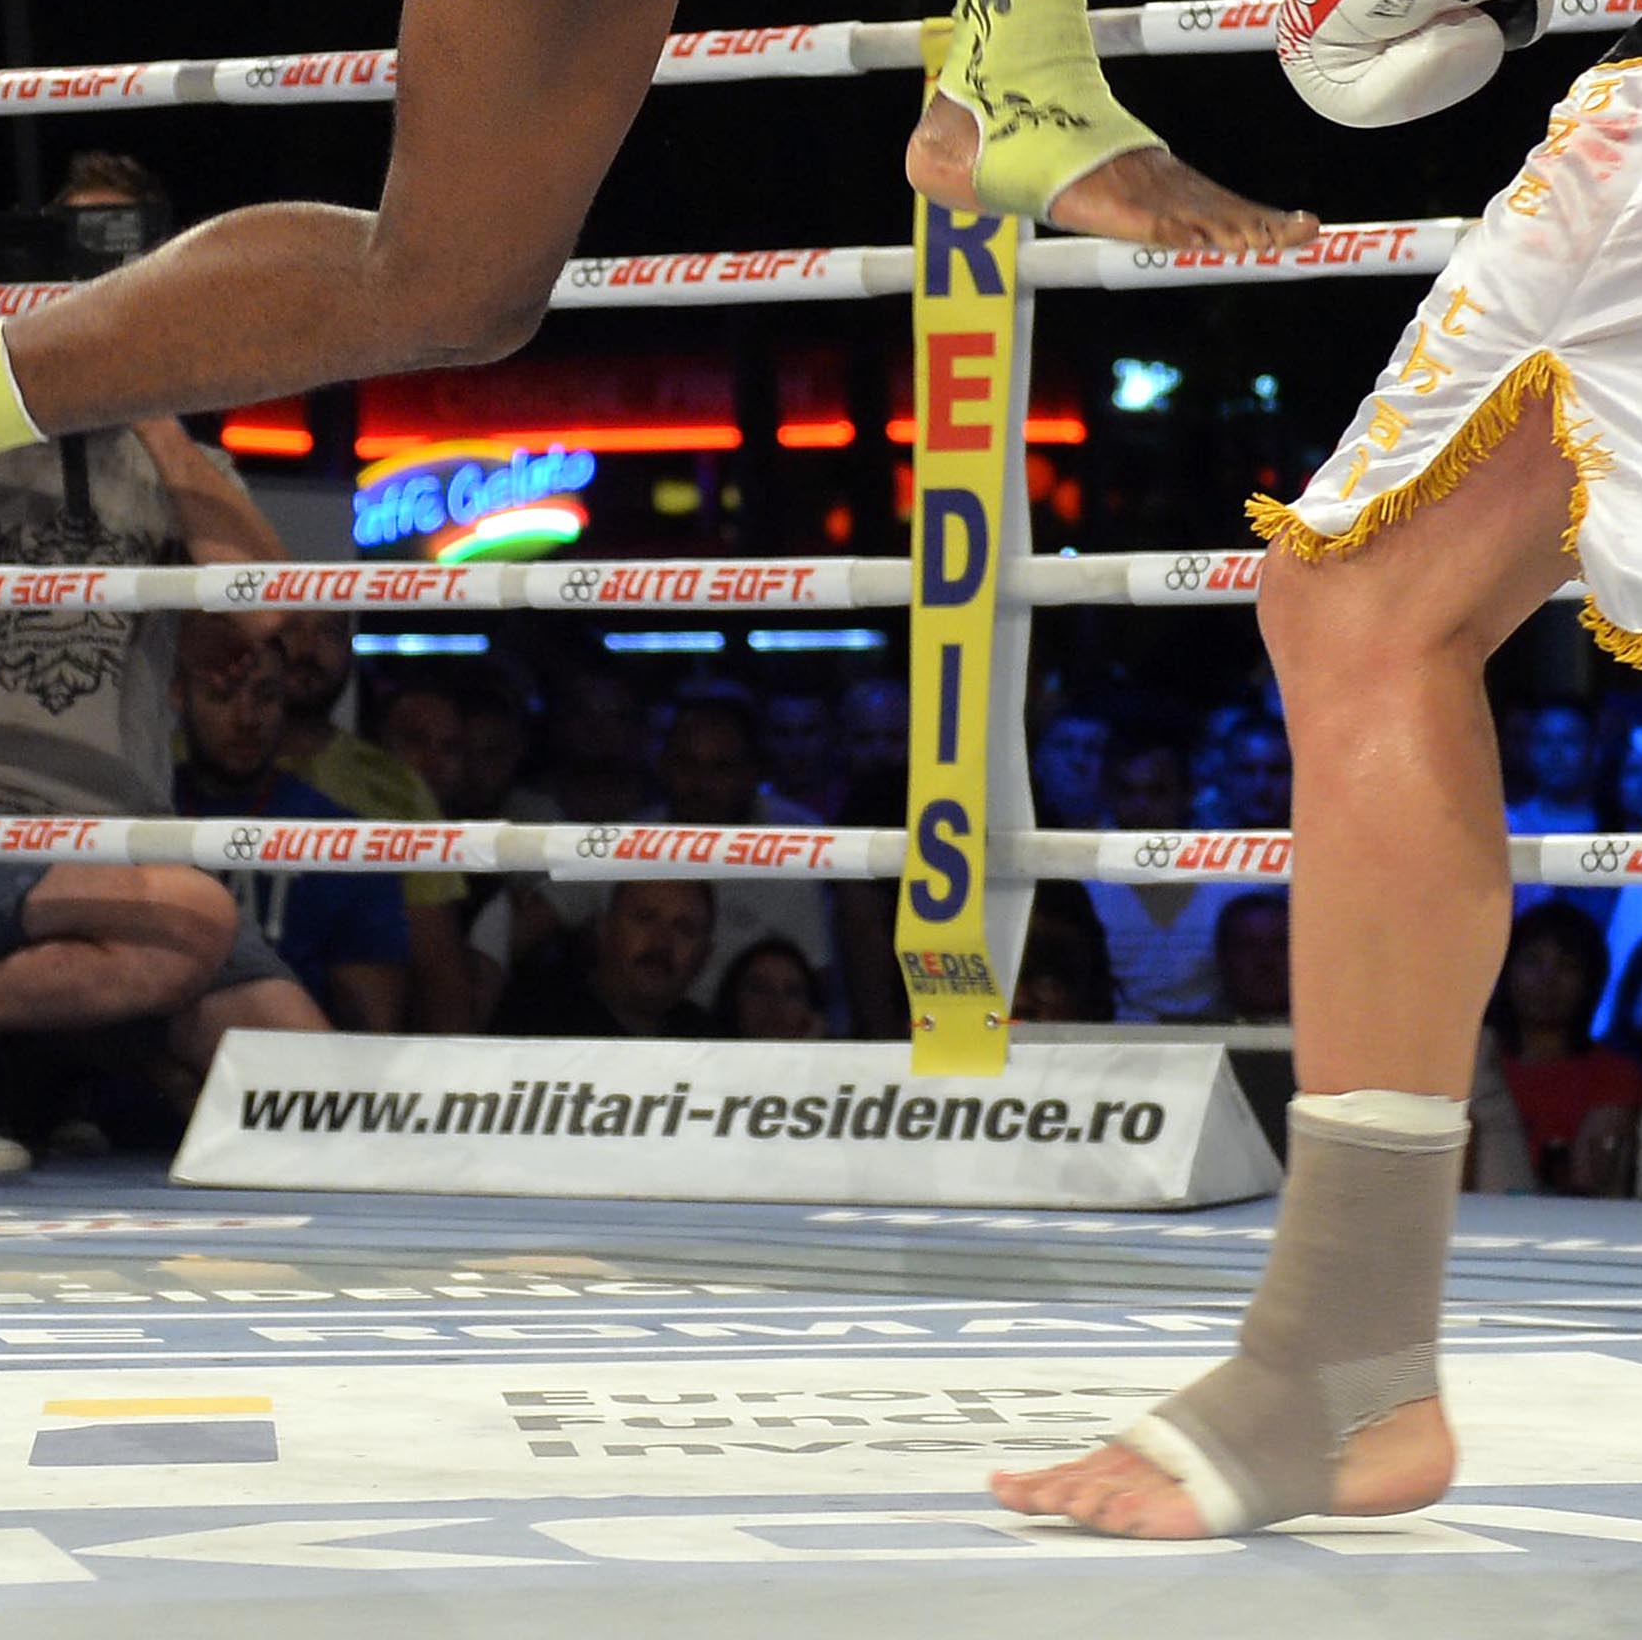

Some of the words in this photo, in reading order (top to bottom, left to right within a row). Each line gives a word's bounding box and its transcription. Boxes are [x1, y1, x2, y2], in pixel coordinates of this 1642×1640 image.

[909, 202, 1008, 922] REDIS
[241, 1079, 1166, 1146] www.militari-residence.ro
[501, 1386, 1179, 1407] Europe
[513, 1407, 1112, 1431] Funds
